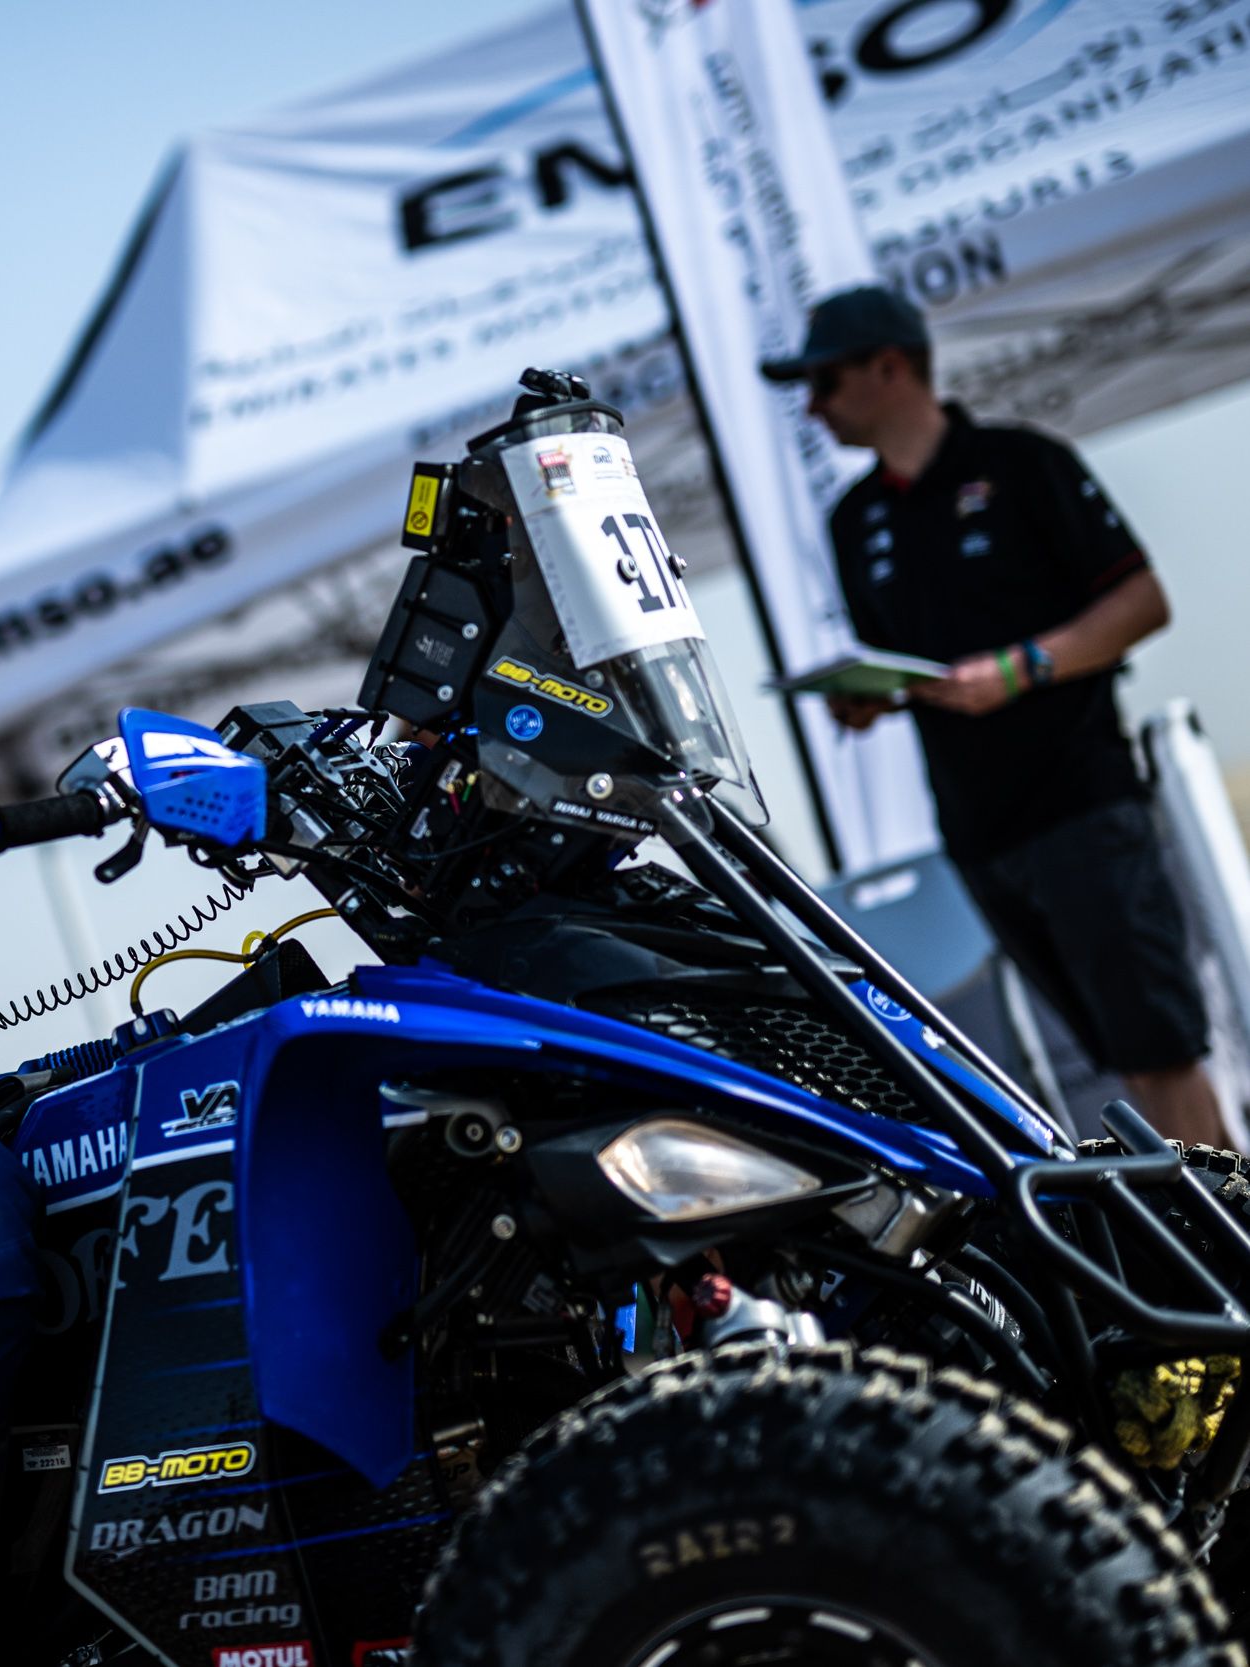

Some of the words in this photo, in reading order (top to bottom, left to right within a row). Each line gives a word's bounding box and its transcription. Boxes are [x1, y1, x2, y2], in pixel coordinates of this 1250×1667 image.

[494, 660, 609, 714] BB-MOTO
[553, 800, 592, 818] JURAJ
[595, 805, 639, 829] VARGA
[300, 999, 400, 1024] YAMAHA
[21, 1121, 128, 1188] AMAHA
[103, 1449, 250, 1487] BB-MOTO
[90, 1502, 269, 1550] DRAGON
[194, 1569, 277, 1602] BAM
[179, 1603, 302, 1630] racing
[218, 1645, 310, 1667] MOTUL
